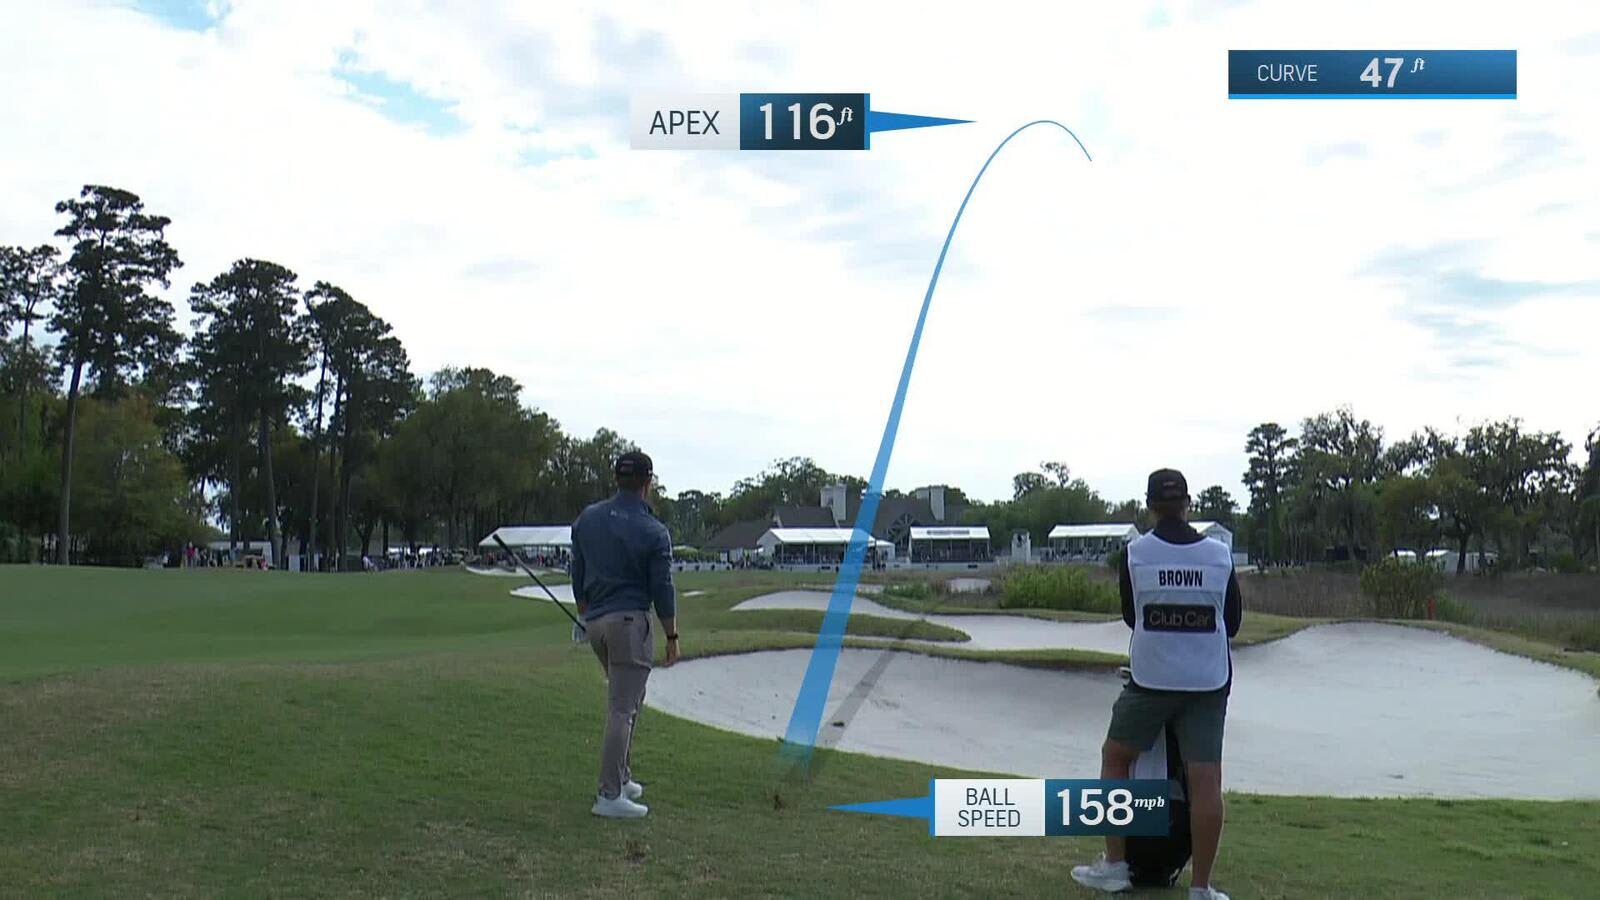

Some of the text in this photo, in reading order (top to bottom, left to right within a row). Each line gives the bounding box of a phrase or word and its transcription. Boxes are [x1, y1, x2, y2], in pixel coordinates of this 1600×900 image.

[1158, 569, 1203, 587] BROWN
[1149, 610, 1211, 627] Club Car
